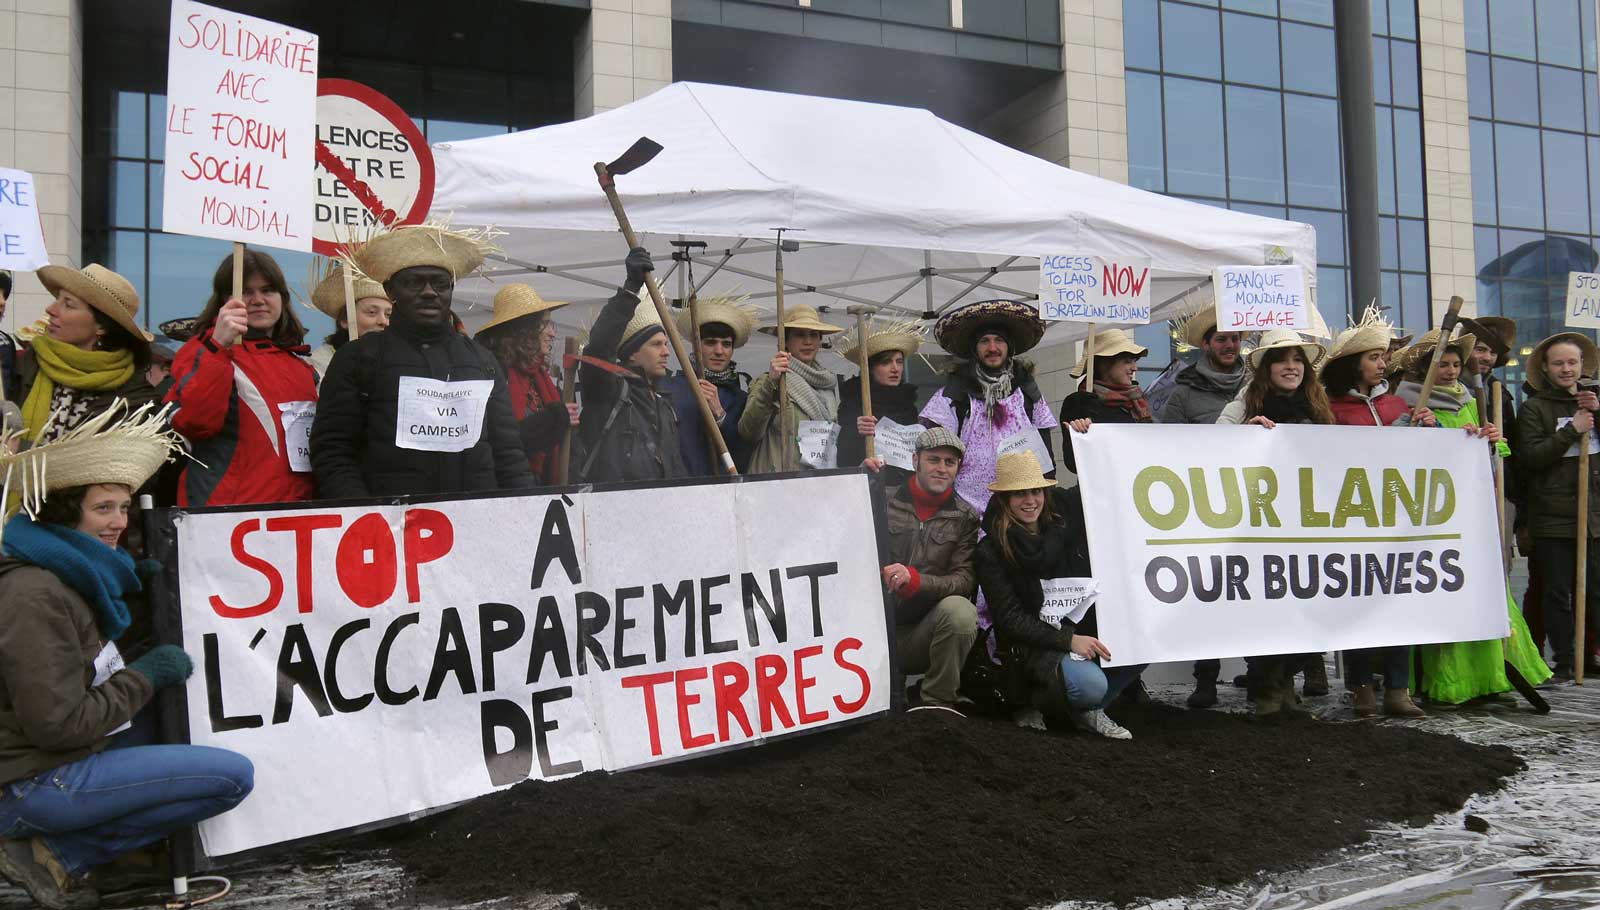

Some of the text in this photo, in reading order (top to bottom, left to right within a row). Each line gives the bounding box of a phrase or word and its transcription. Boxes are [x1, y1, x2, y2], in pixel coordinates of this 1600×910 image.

[216, 69, 269, 103] AVEC
[168, 104, 287, 159] LE FORUM
[201, 196, 299, 238] MONDIAL
[1043, 256, 1093, 271] ACCESS
[1046, 272, 1098, 288] TO LAND
[1103, 263, 1149, 297] NOW
[1056, 288, 1086, 303] FOR
[1224, 271, 1285, 291] BANQUE
[1236, 291, 1301, 307] MONDIALE
[1573, 297, 1600, 318] LAN
[1232, 306, 1295, 327] DÉGAGE
[437, 407, 458, 417] VIA
[1132, 465, 1456, 530] OUR LAND
[208, 493, 582, 619] STOP À
[1144, 549, 1465, 603] OUR BUSINESS
[203, 561, 839, 733] L'ACCAPAREMENT
[481, 637, 872, 787] DE TERRES
